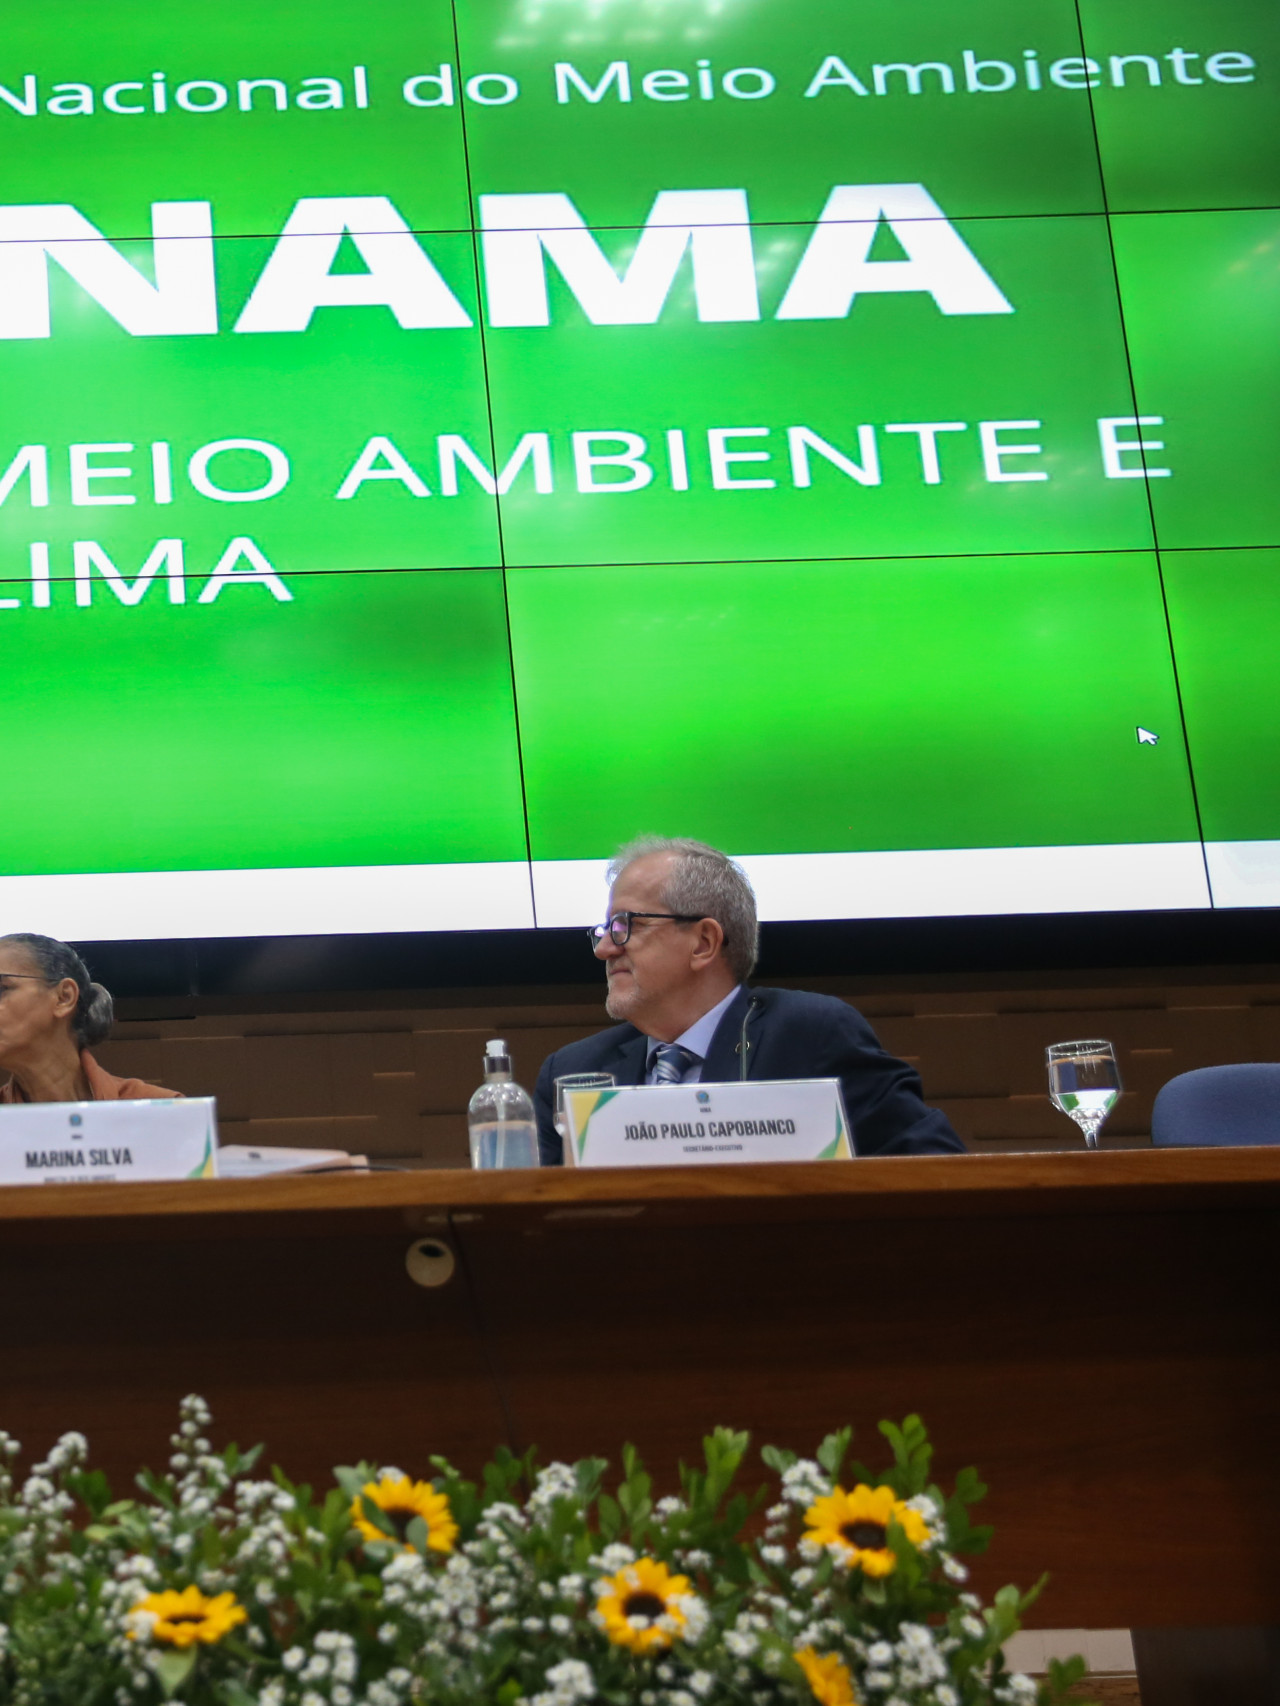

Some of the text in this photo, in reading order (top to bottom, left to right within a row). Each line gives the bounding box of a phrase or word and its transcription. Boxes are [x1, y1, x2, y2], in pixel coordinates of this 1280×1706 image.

[402, 64, 519, 107] do
[554, 60, 775, 104] Meio
[804, 47, 1256, 98] Ambiente
[335, 420, 1048, 500] AMBIENTE
[1097, 416, 1172, 480] E
[625, 1119, 795, 1141] JOÃO PAULO CAPOBIANCO
[25, 1148, 132, 1168] MARINA SILVA
